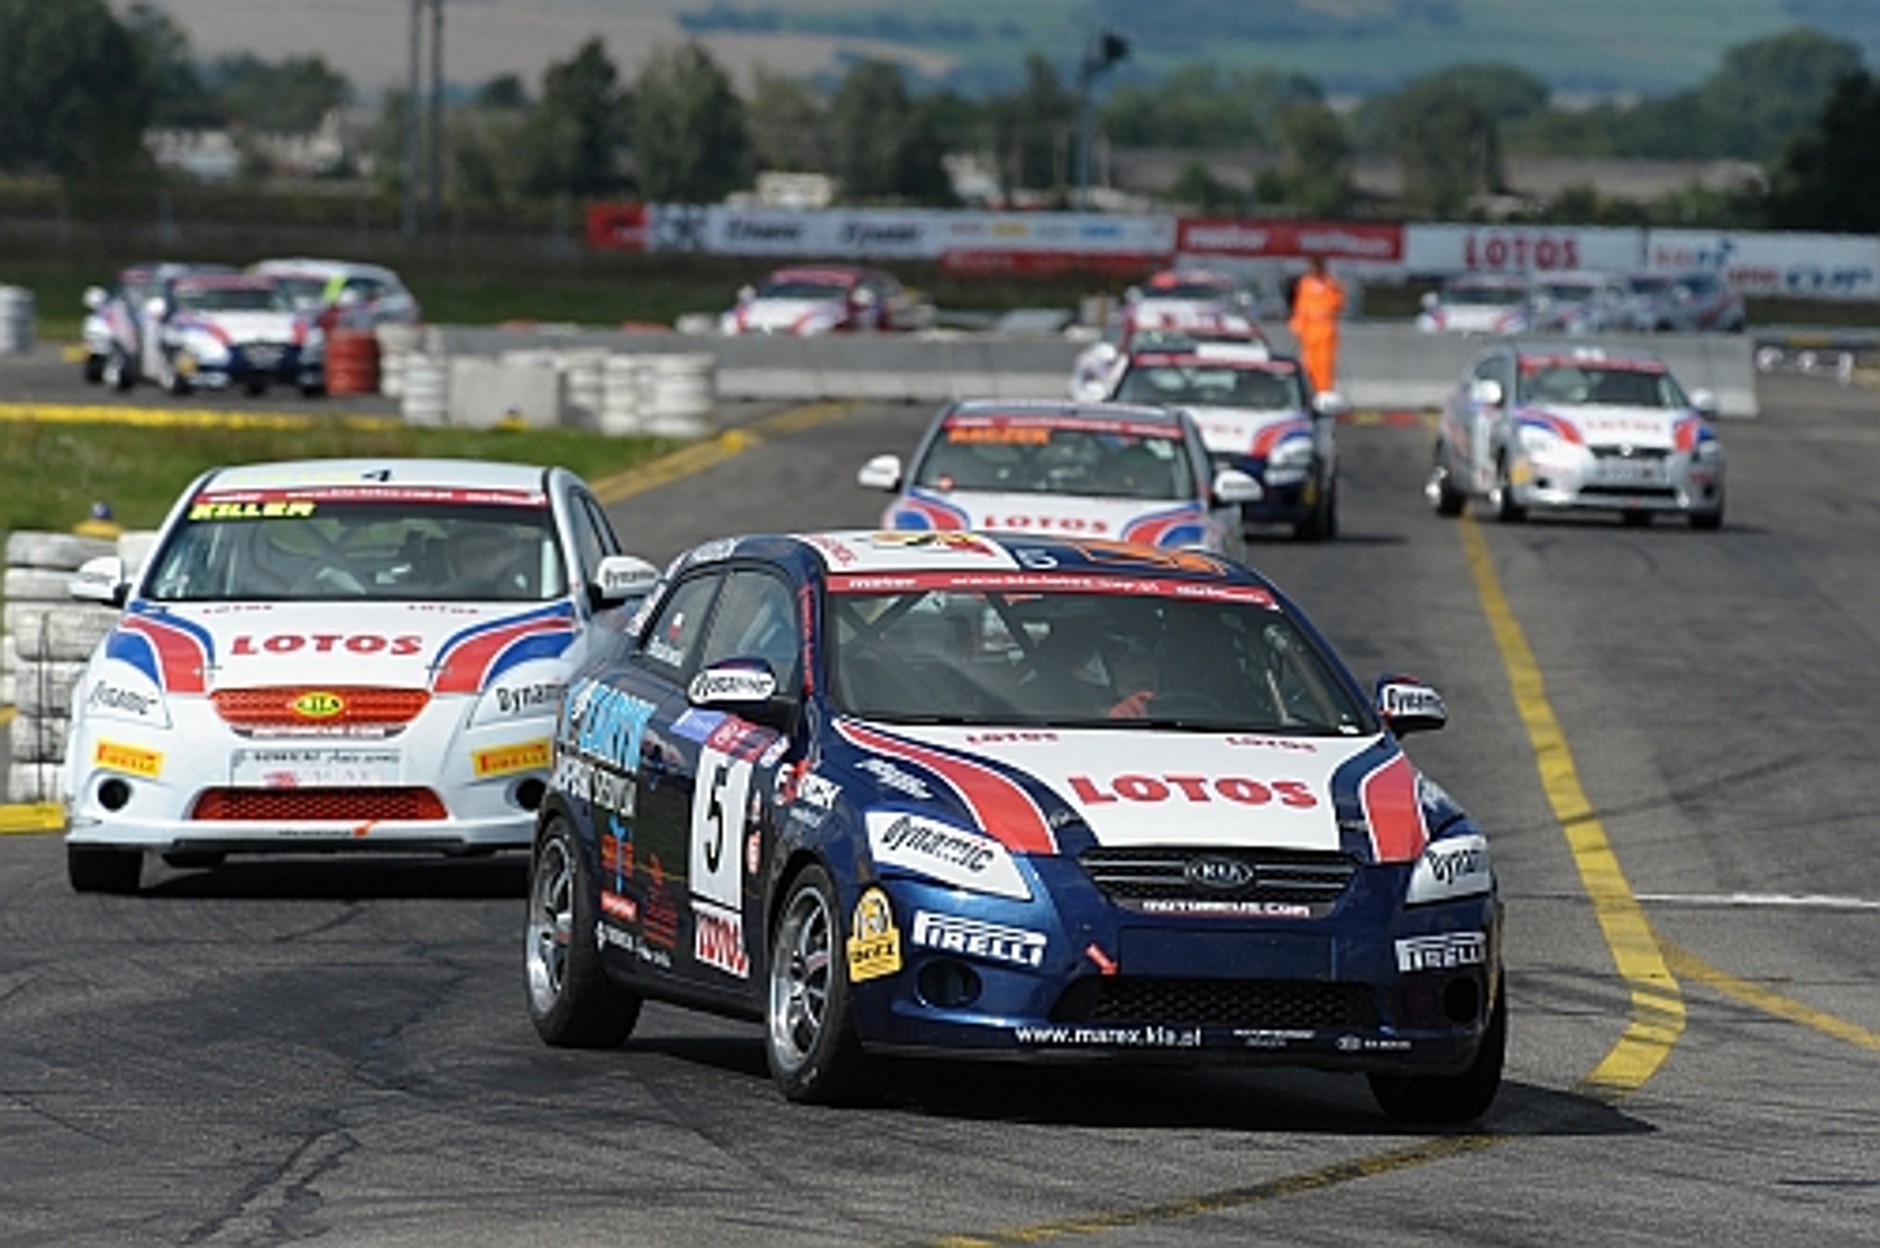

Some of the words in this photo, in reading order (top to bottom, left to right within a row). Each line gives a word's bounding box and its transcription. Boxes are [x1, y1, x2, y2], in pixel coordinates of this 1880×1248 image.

[1463, 233, 1582, 270] LOTOS
[188, 501, 319, 520] KILLER
[984, 514, 1108, 532] LOTOS
[230, 633, 424, 656] LOTOS
[1066, 774, 1319, 807] LOTOS
[701, 763, 727, 874] 5
[880, 814, 995, 873] Dynamic
[911, 908, 1048, 966] PIRELLI
